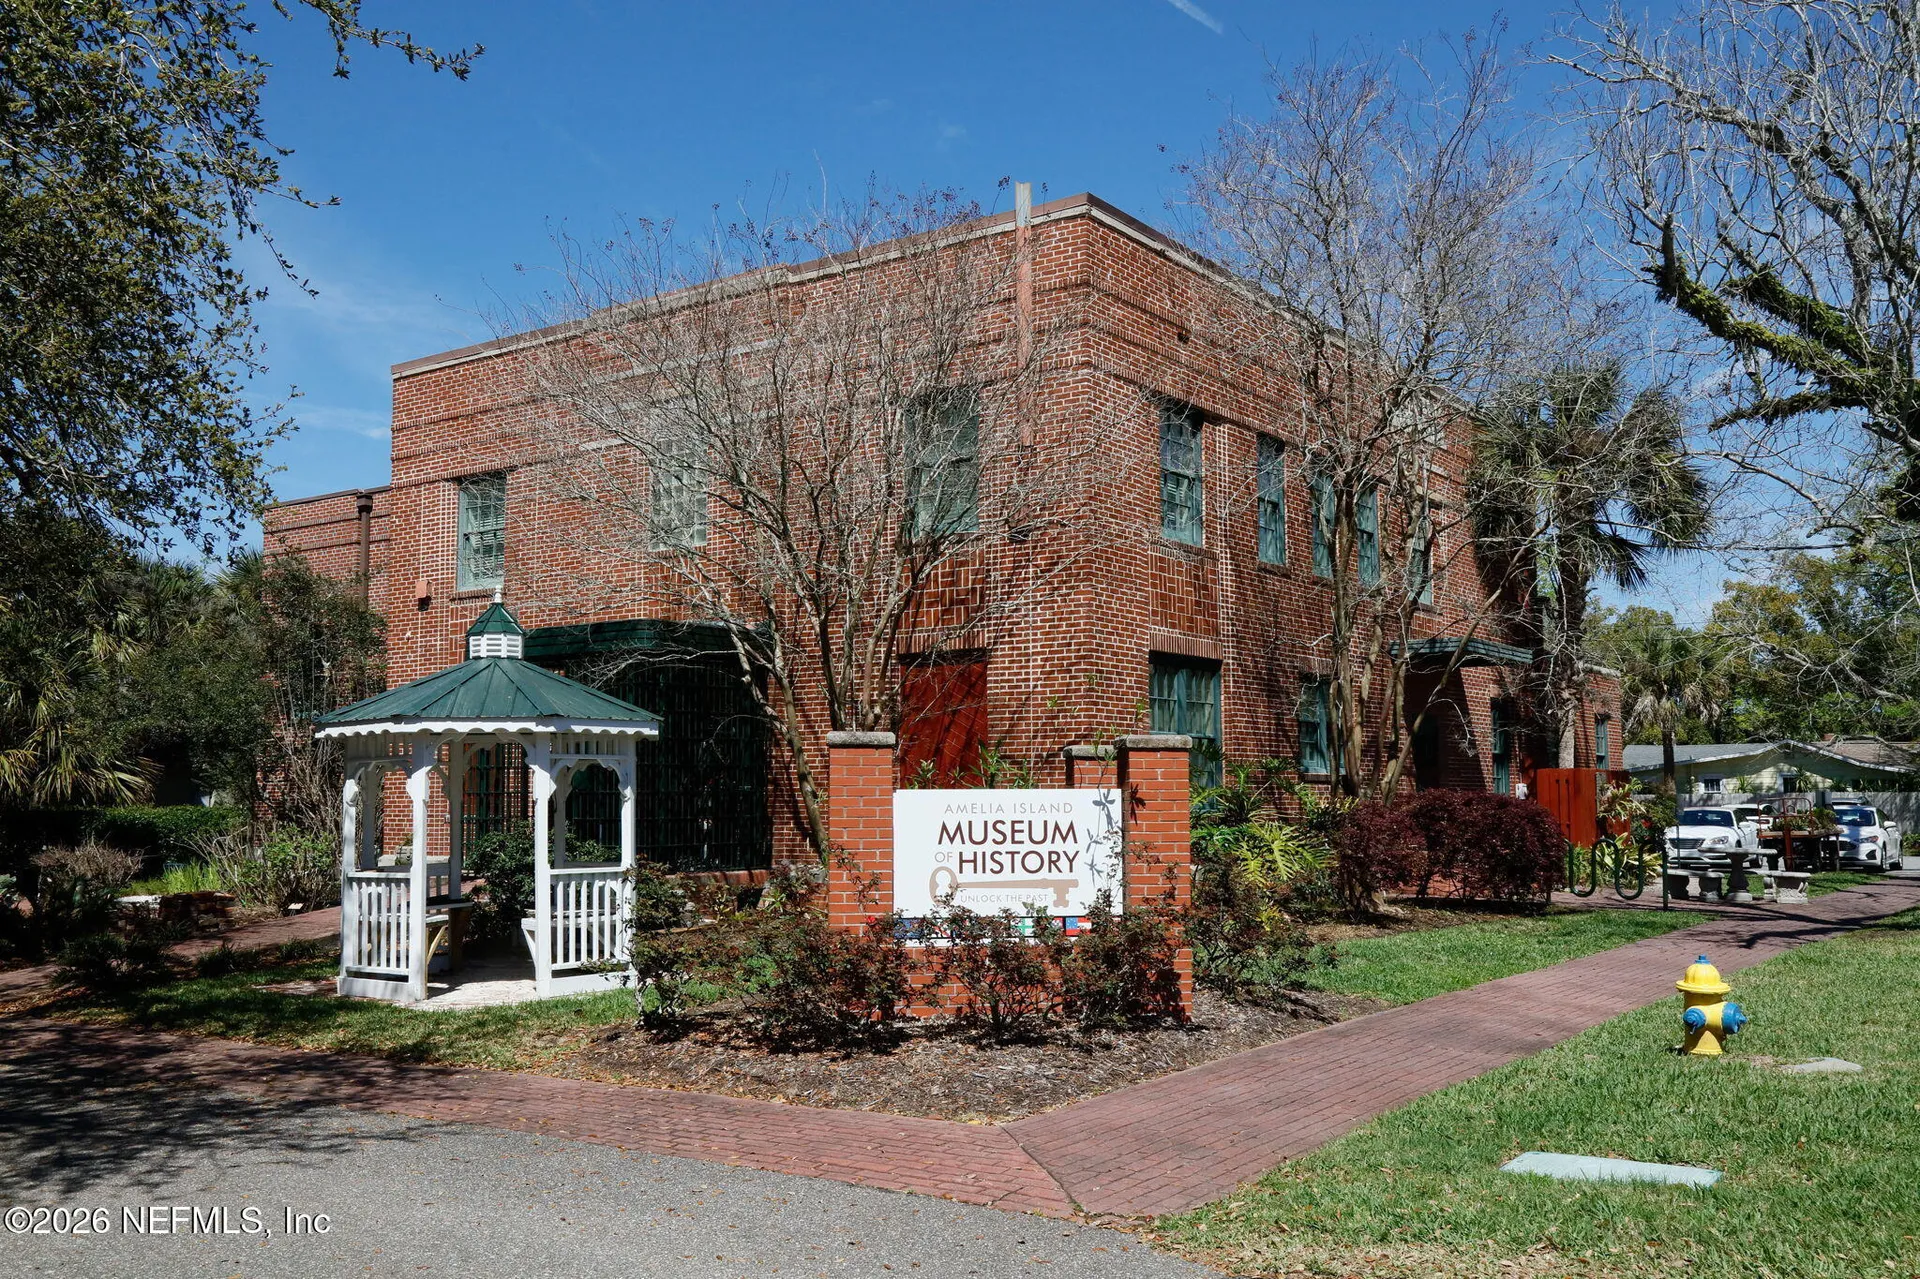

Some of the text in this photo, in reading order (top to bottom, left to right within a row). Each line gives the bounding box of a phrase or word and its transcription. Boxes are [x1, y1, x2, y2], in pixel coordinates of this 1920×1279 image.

[944, 802, 1073, 814] AMELIA ISLAND
[938, 820, 1078, 845] MUSEUM
[934, 850, 1080, 874] OF HISTORY
[960, 894, 1048, 903] UNLOCK THE PAST
